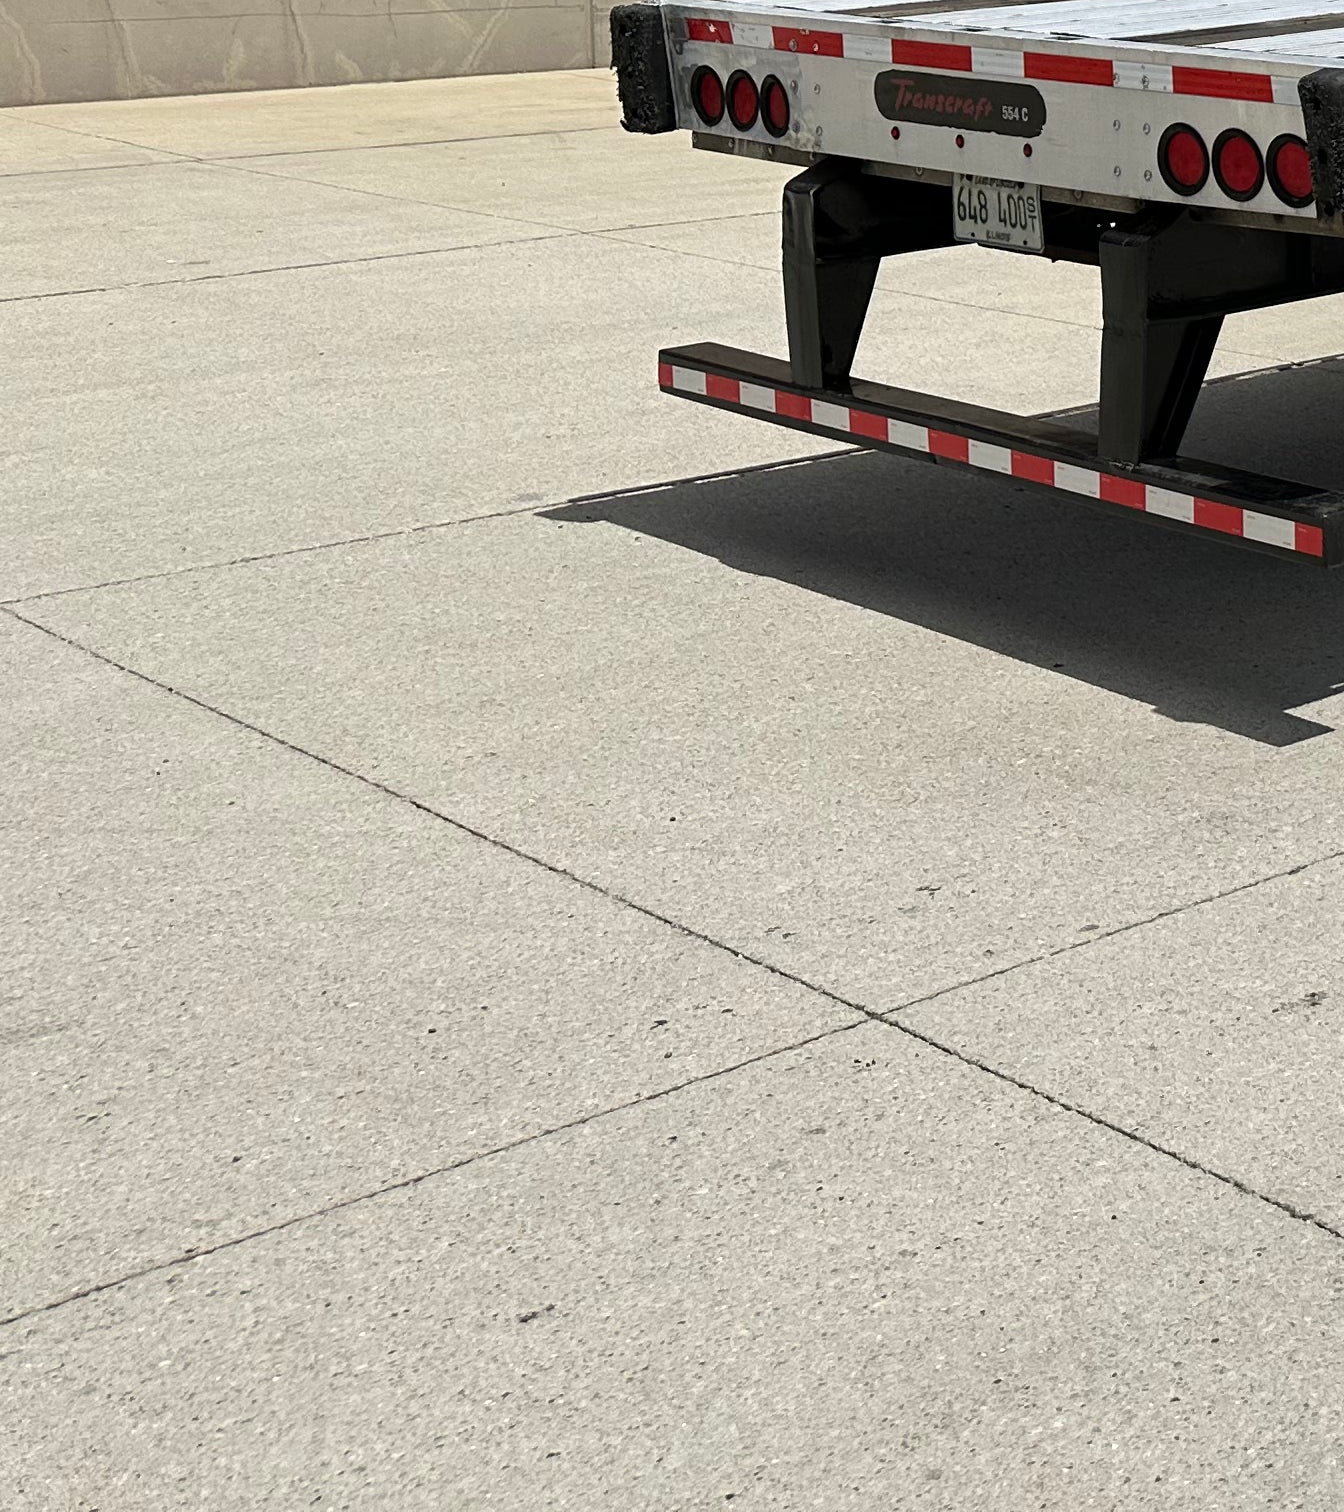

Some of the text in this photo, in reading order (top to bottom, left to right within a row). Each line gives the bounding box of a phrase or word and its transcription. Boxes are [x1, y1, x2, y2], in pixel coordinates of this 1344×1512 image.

[890, 78, 1029, 122] Transcraft 554 C
[957, 186, 1027, 230] 648 400
